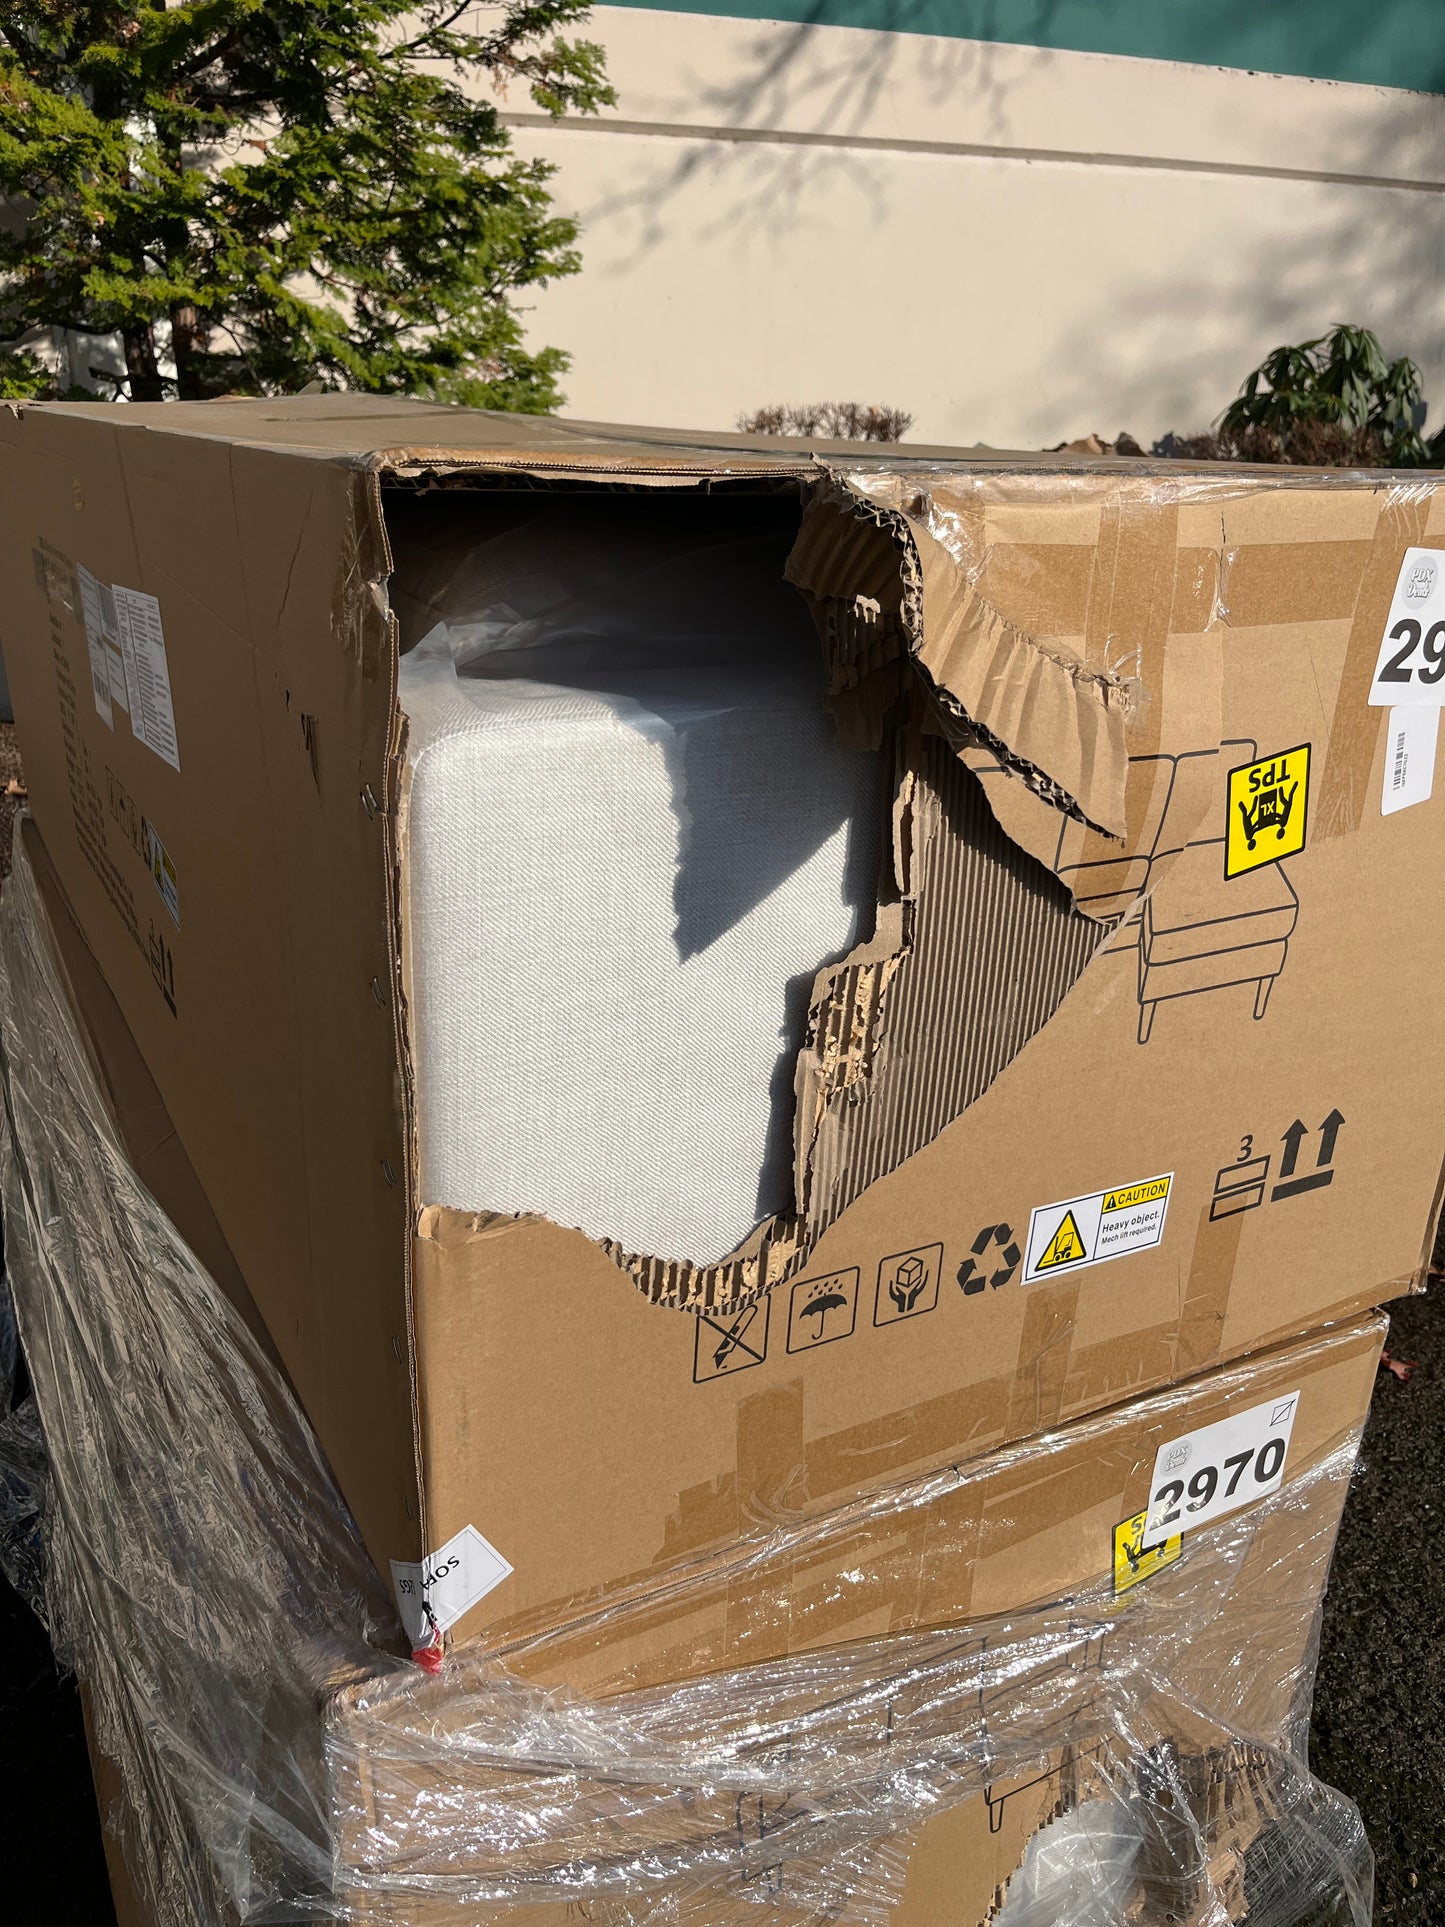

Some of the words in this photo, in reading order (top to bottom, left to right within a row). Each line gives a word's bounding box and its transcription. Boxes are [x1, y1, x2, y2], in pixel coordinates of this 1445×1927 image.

[1410, 568, 1434, 583] PDX
[1248, 759, 1291, 793] TPS
[1260, 801, 1276, 817] XL
[1236, 1134, 1254, 1162] 3
[1117, 1182, 1166, 1205] CAUTION
[1101, 1233, 1119, 1245] Mech
[1119, 1231, 1129, 1241] lift
[1128, 1223, 1157, 1239] required.
[1102, 1218, 1130, 1234] Heavy
[1130, 1210, 1160, 1227] object.
[1149, 1437, 1286, 1532] 2970
[419, 1555, 460, 1590] SOFA
